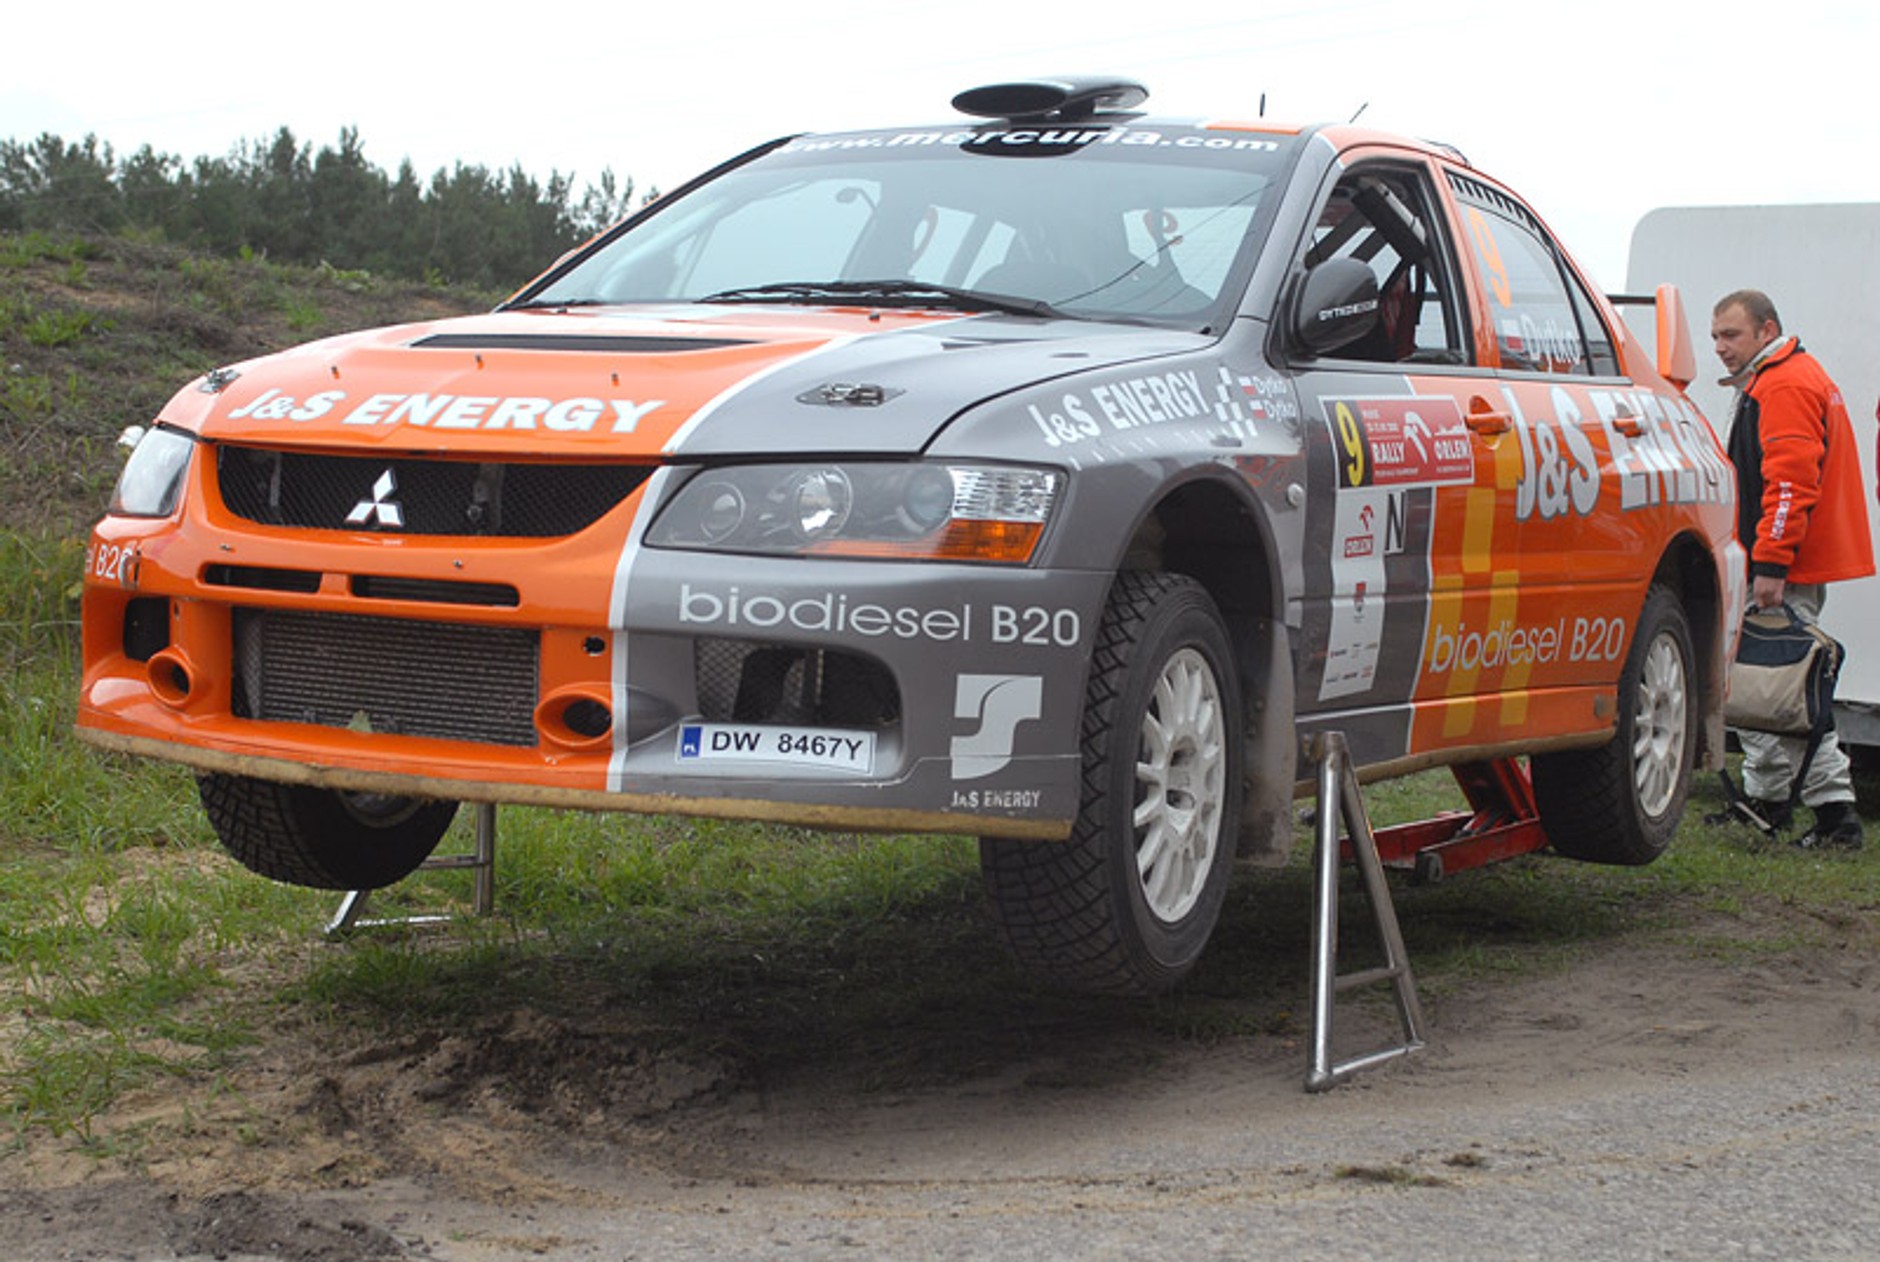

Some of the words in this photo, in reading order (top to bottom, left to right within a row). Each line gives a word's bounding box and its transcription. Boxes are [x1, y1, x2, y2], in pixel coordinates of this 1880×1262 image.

[1469, 206, 1512, 308] 9
[227, 388, 347, 422] J&S
[342, 394, 664, 434] ENERGY
[1027, 394, 1101, 447] J&S
[1091, 370, 1209, 430] ENERGY
[1335, 401, 1364, 488] 9
[1371, 441, 1405, 465] RALLY
[1502, 384, 1600, 522] J&S
[1385, 490, 1405, 551] N
[679, 584, 971, 641] biodiesel
[991, 605, 1080, 647] B20
[1429, 617, 1565, 673] biodiesel
[1569, 617, 1626, 661] B20
[711, 731, 762, 752] DW
[777, 732, 864, 761] 8467Y
[983, 789, 1041, 808] ENERGY
